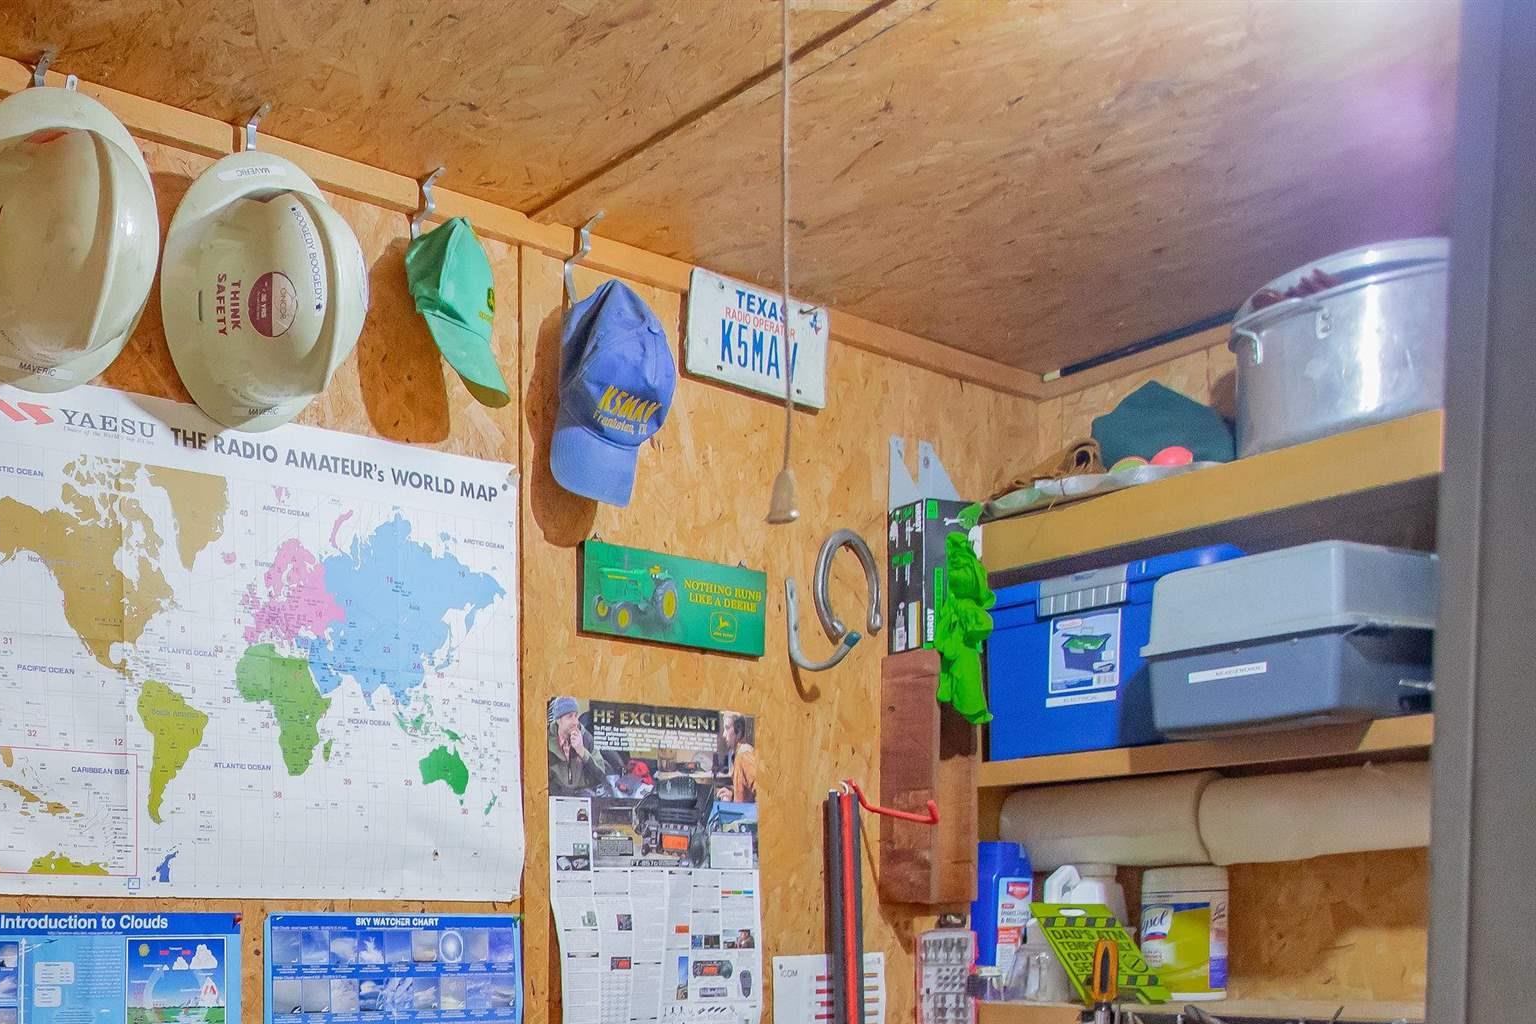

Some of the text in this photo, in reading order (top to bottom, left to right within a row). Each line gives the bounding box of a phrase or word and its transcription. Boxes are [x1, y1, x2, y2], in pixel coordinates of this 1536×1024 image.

[236, 167, 270, 176] MAVERIC
[294, 210, 323, 302] BOOGEDY BOOGEDY
[216, 272, 228, 336] SAFETY
[230, 280, 242, 330] THINK
[736, 290, 789, 324] TEXAS
[725, 306, 796, 341] RADIO OPERATR
[18, 362, 56, 377] MAVERIC
[248, 407, 280, 416] MAVERIC
[60, 408, 156, 438] YAESU
[170, 427, 498, 502] THE RADIO AMATEUR's WORLD MAP
[16, 467, 44, 478] OCEAN
[262, 504, 310, 518] ARCTIC OCEAN
[464, 538, 505, 550] ARCTIC OCEAN
[684, 579, 762, 602] NOTHING RUNS
[688, 592, 757, 613] LIKE A DEERE
[2, 636, 14, 645] 31
[158, 646, 218, 658] ATLANTIC OCEAN
[16, 664, 75, 676] PACIFIC OCEAN
[471, 698, 510, 708] PACIFIC OCEAN
[348, 718, 390, 728] INDIAN OCEAN
[593, 708, 718, 731] HF EXCITEMENT
[28, 729, 38, 738] 32
[114, 738, 124, 747] 12
[71, 766, 130, 776] CARIBBEAN SEA
[214, 762, 272, 772] ATLANTIC OCEAN
[0, 914, 169, 929] Introduction to Clouds
[355, 918, 440, 926] SKY WATCHER CHART
[1141, 909, 1169, 936] ysol
[1050, 930, 1096, 940] DAD'S
